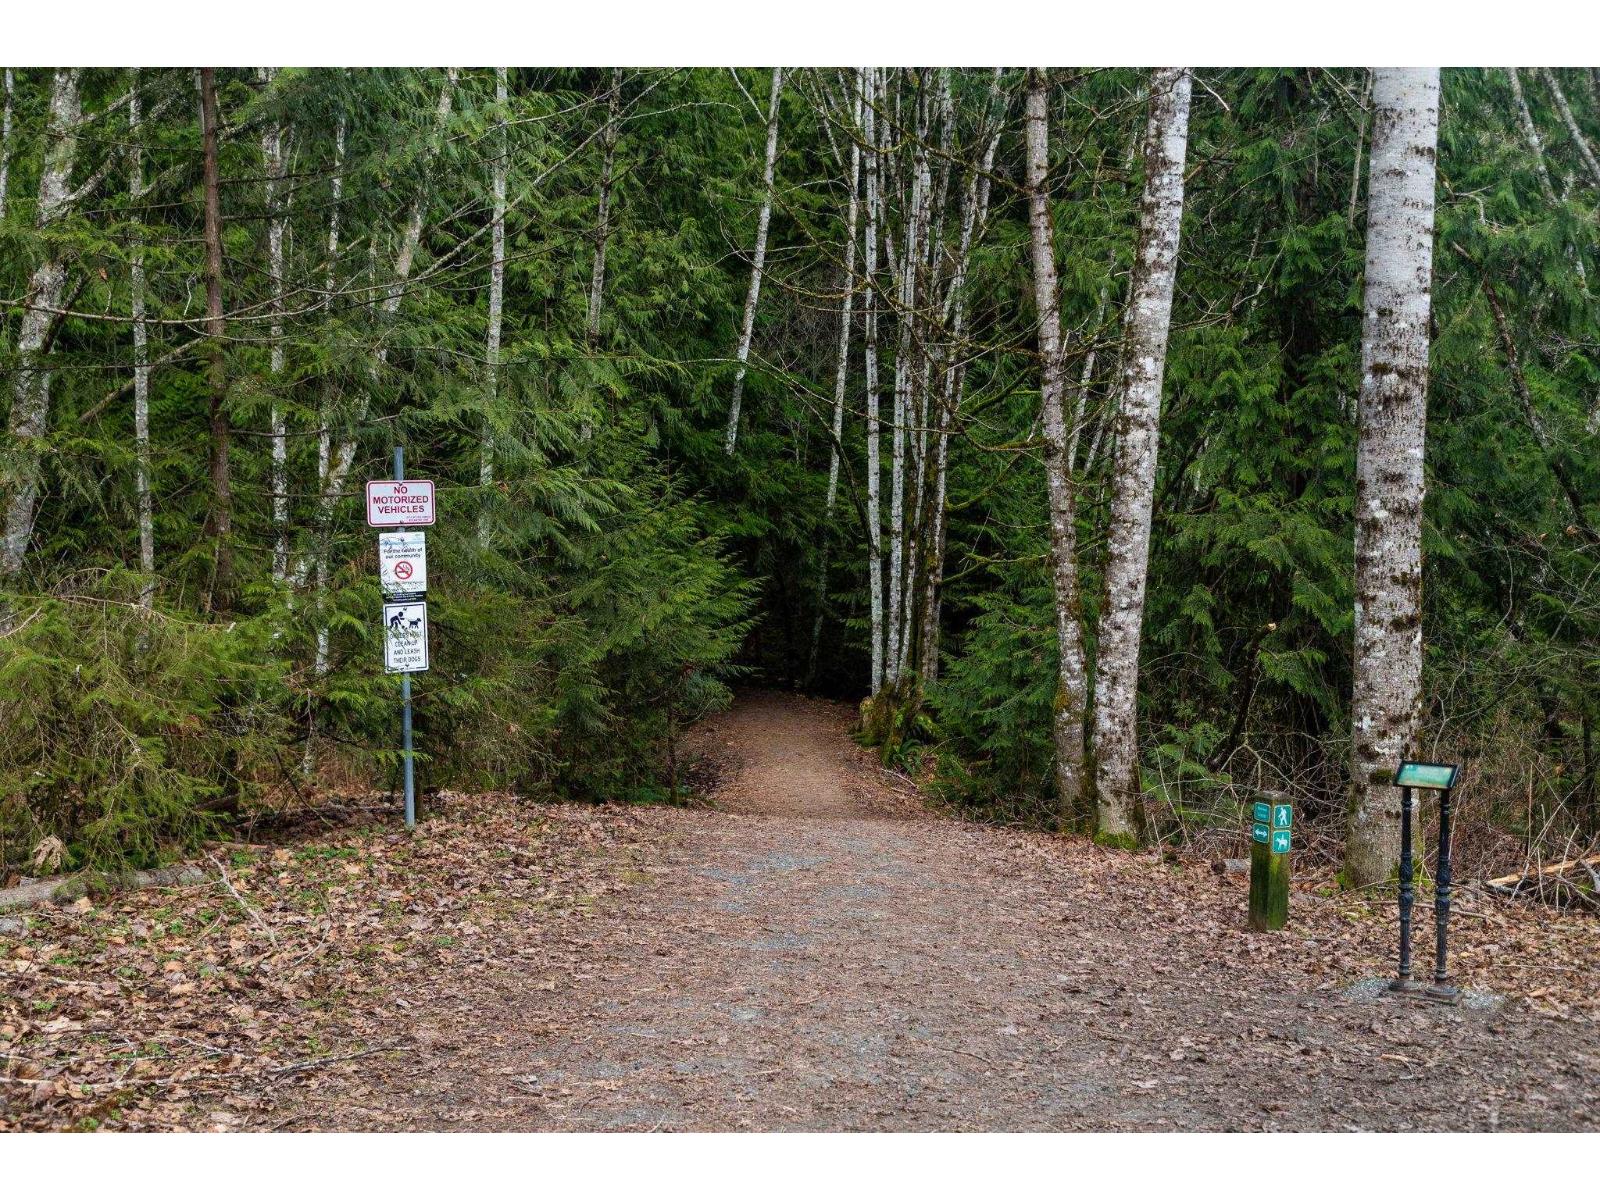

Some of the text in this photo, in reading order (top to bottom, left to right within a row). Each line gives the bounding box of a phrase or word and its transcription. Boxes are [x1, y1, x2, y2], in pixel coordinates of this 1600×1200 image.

[394, 486, 408, 494] NO
[373, 496, 428, 504] MOTORIZED
[378, 505, 425, 514] VEHICLES
